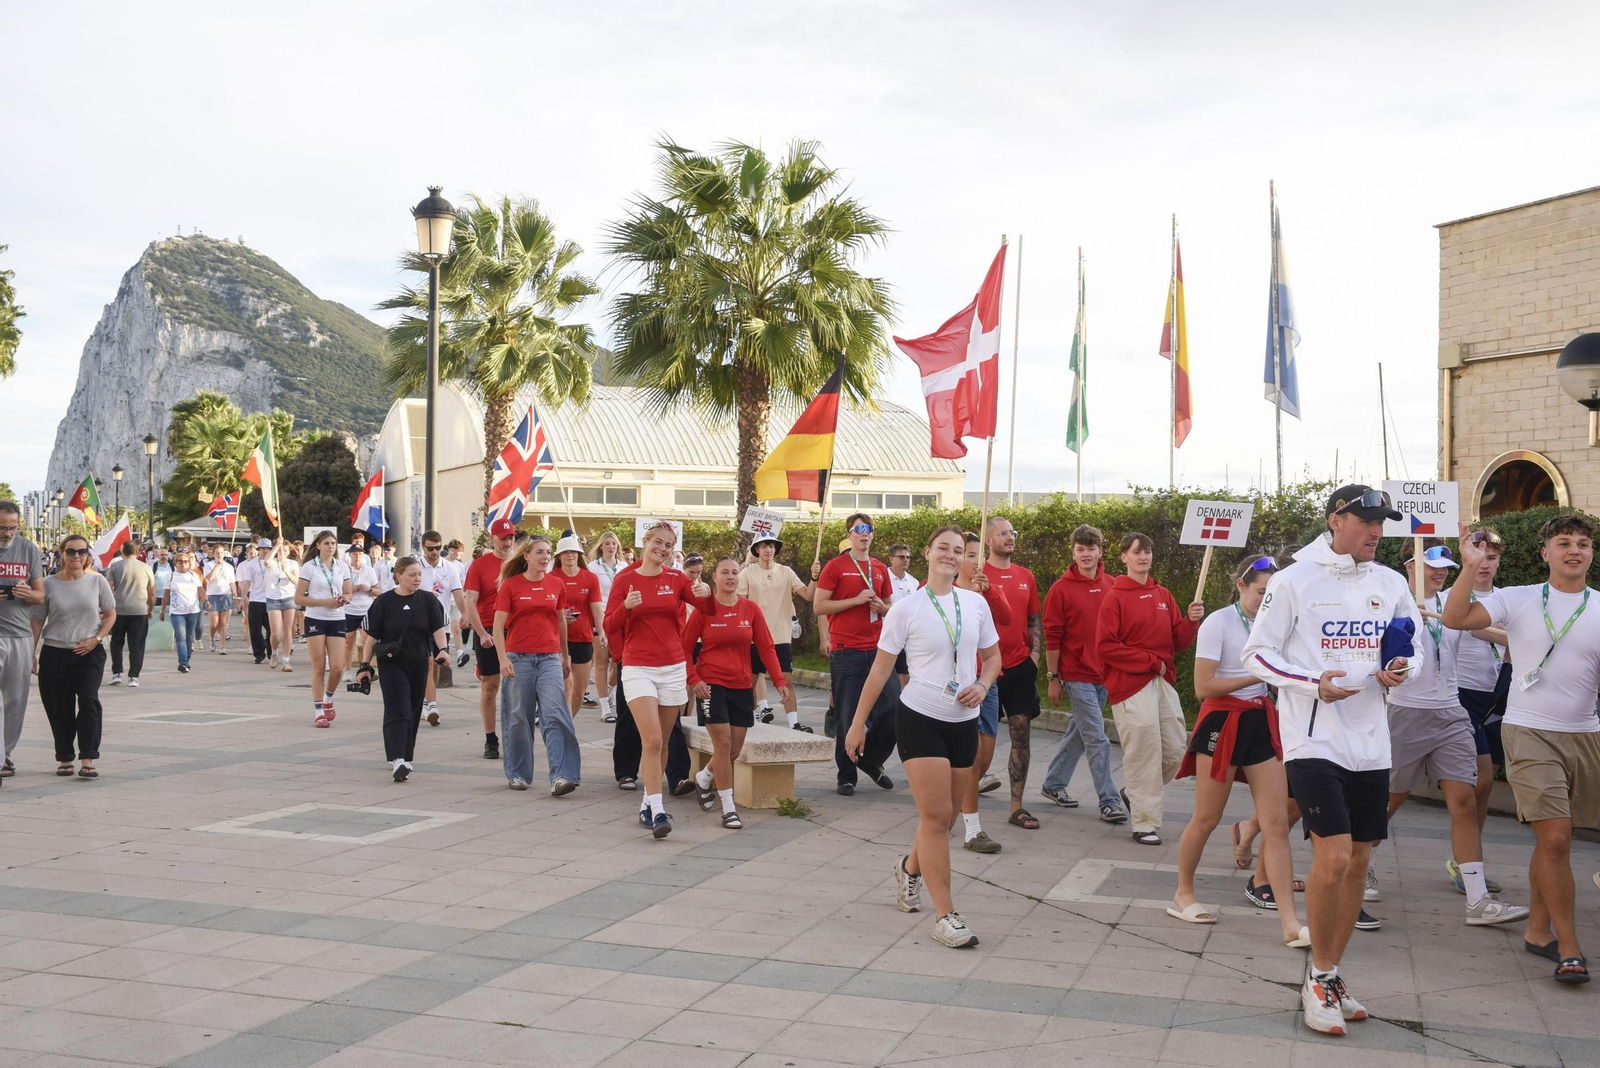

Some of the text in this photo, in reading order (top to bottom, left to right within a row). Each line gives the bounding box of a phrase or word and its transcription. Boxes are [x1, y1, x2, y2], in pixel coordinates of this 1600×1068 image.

[1402, 482, 1436, 495] CZECH
[1196, 506, 1244, 520] DENMARK
[1397, 501, 1446, 514] REPUBLIC
[747, 509, 784, 523] GREAT BRITAIN
[1321, 620, 1387, 637] CZECH
[1321, 638, 1379, 649] REPUBLI
[1322, 651, 1379, 663] チェコ共和
